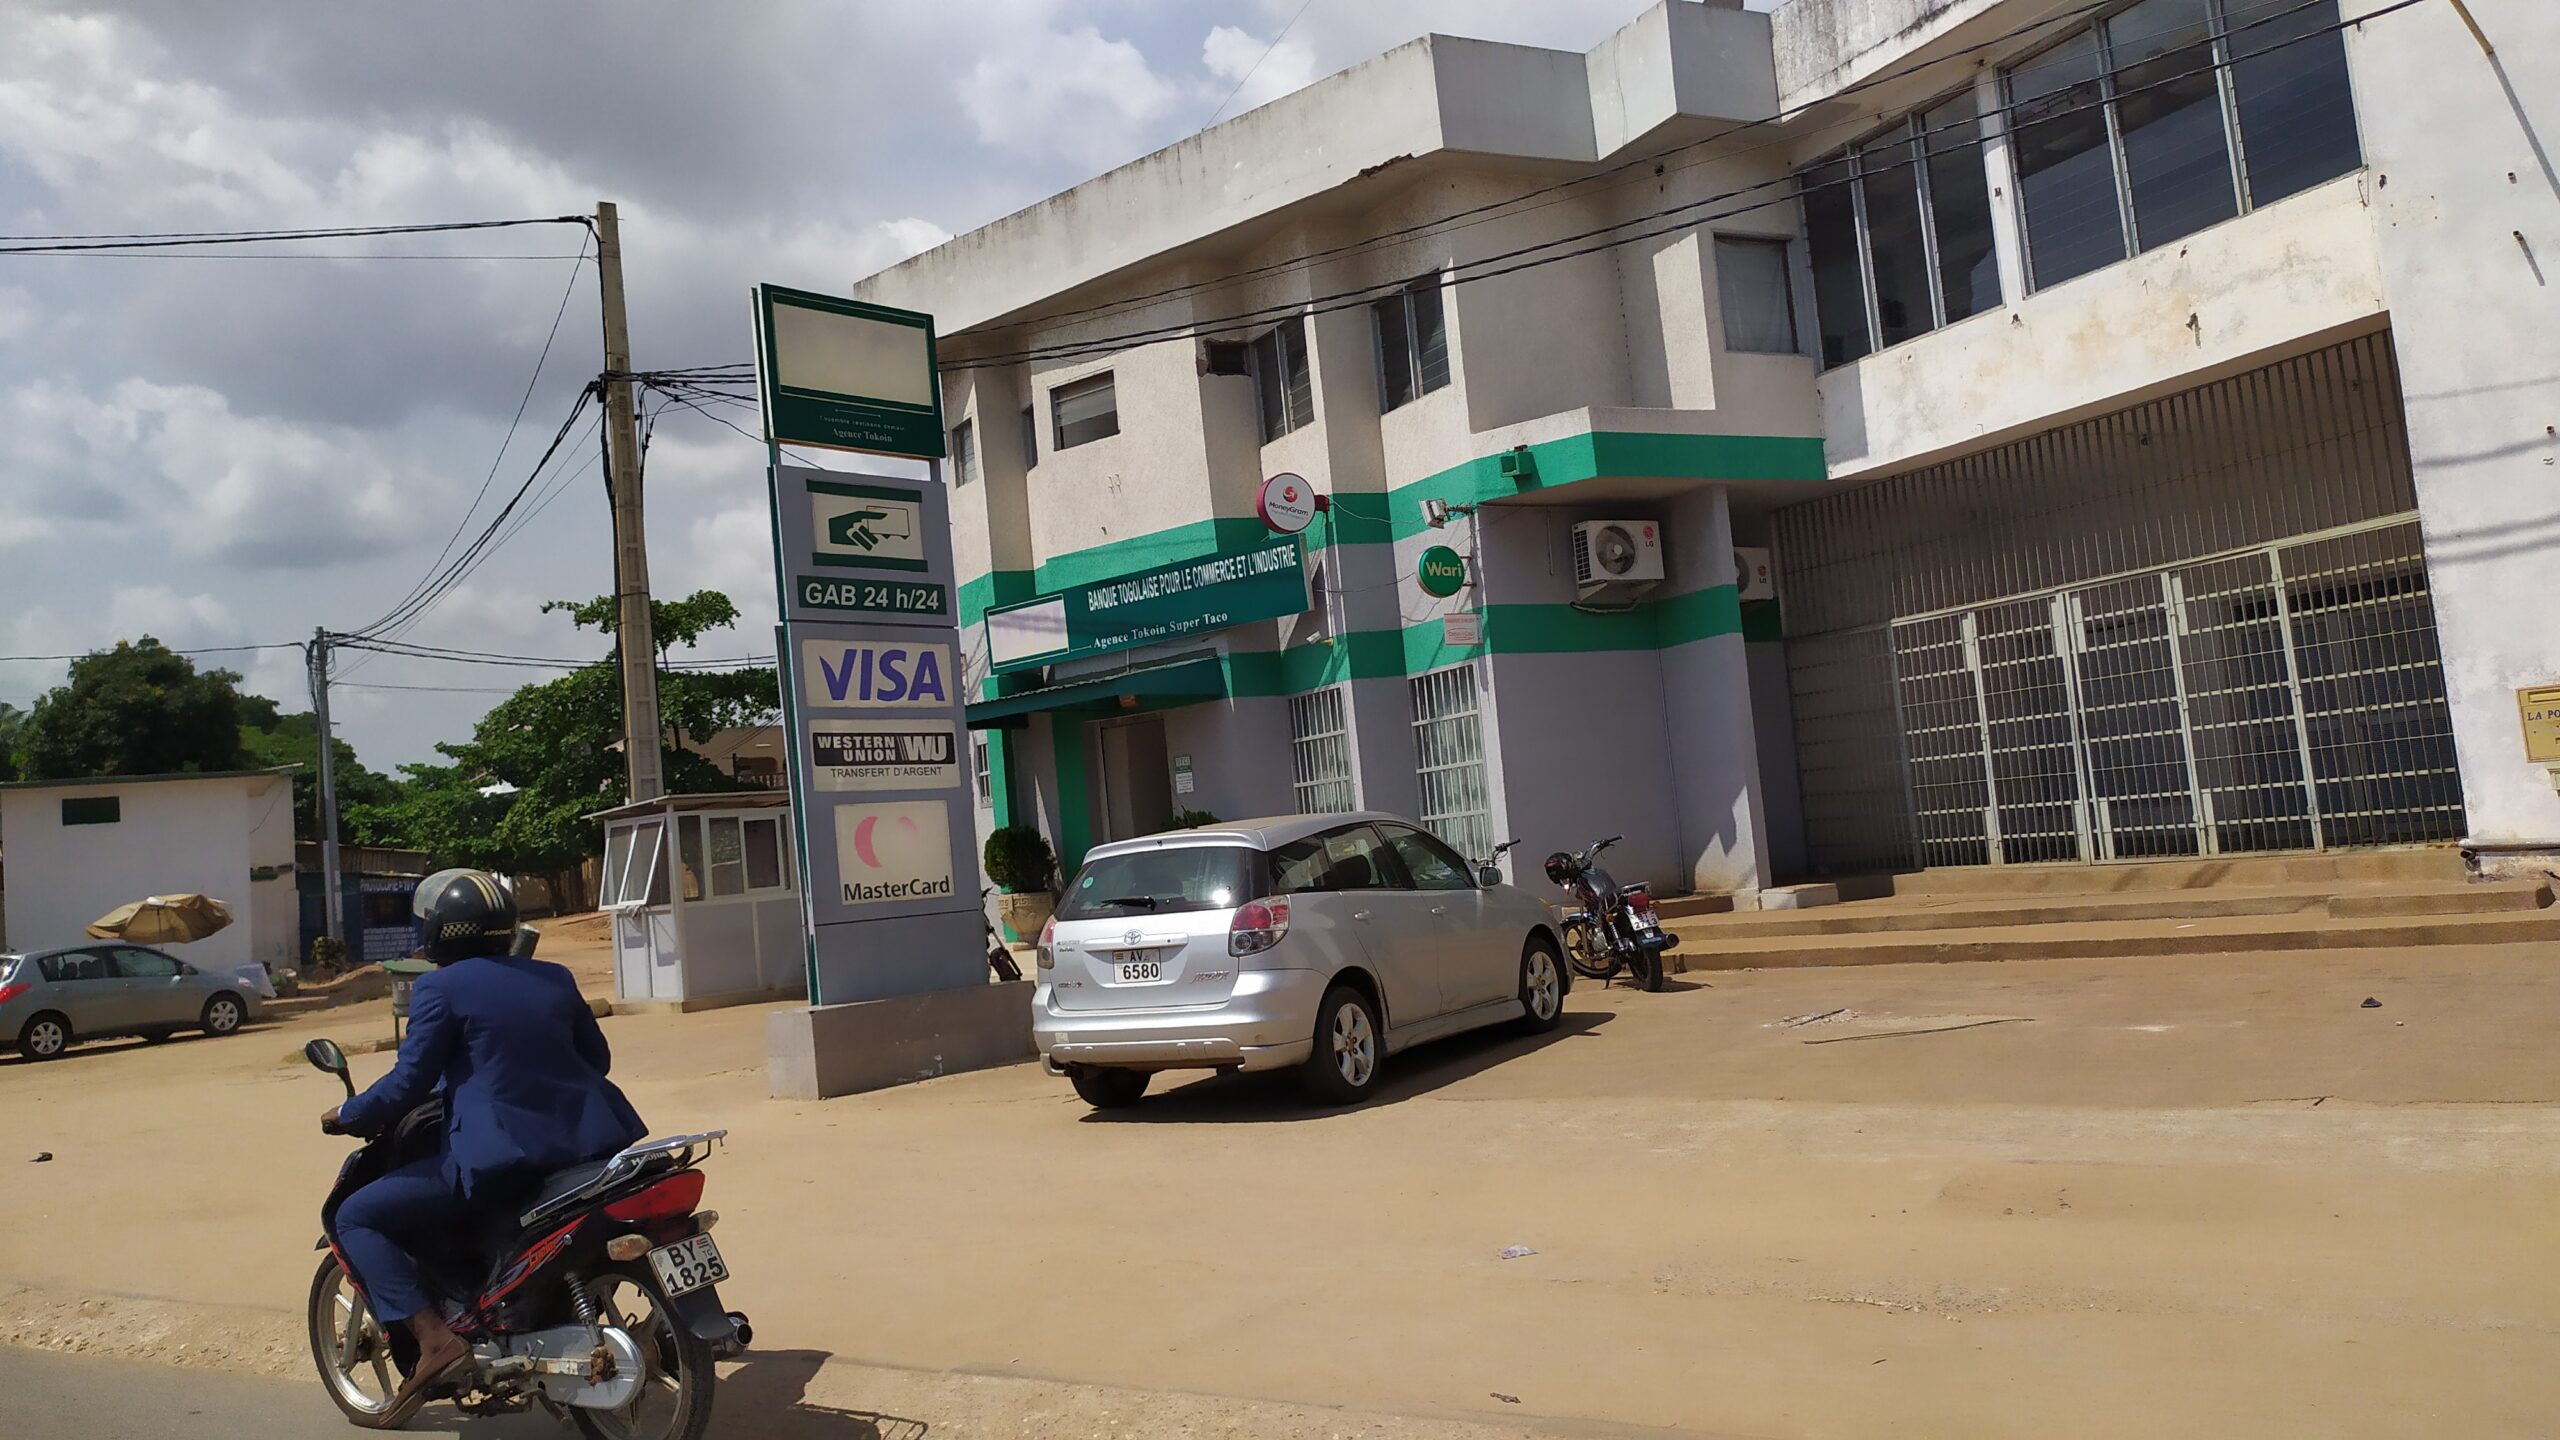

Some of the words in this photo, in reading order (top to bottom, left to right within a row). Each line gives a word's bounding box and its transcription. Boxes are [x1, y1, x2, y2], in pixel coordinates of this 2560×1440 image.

[832, 428, 862, 439] Agence
[863, 430, 893, 443] Tokoin
[1268, 501, 1309, 516] MoneyGram
[1087, 584, 1118, 612] BANQUE
[1118, 575, 1159, 606] TOGOLAISE
[1159, 571, 1181, 596] POUR
[1181, 570, 1192, 591] LE
[1192, 559, 1235, 589] COMMERCE
[1236, 557, 1247, 579] ET
[1248, 543, 1297, 577] L'INDUSTRIE
[1425, 561, 1462, 578] Wari
[805, 582, 857, 606] GAB
[863, 586, 888, 607] 24
[895, 589, 939, 610] h/24
[1093, 632, 1128, 649] Agence
[1132, 625, 1166, 640] Tokoin
[1169, 618, 1199, 635] Super
[1202, 612, 1229, 626] Taco
[818, 648, 945, 702] VISA
[2527, 711, 2542, 721] LA
[817, 735, 895, 749] WESTERN
[903, 735, 947, 761] WU
[843, 749, 896, 762] UNION
[830, 767, 891, 778] TRANSFERT
[893, 766, 943, 777] D'ARGENT
[843, 875, 950, 901] MasterCard
[1634, 918, 1658, 929] 2713
[1130, 951, 1143, 962] AV
[1123, 963, 1159, 980] 6580
[631, 1151, 668, 1166] Hojue
[666, 1240, 697, 1268] BY
[702, 1248, 713, 1257] TG
[666, 1256, 723, 1294] 1825
